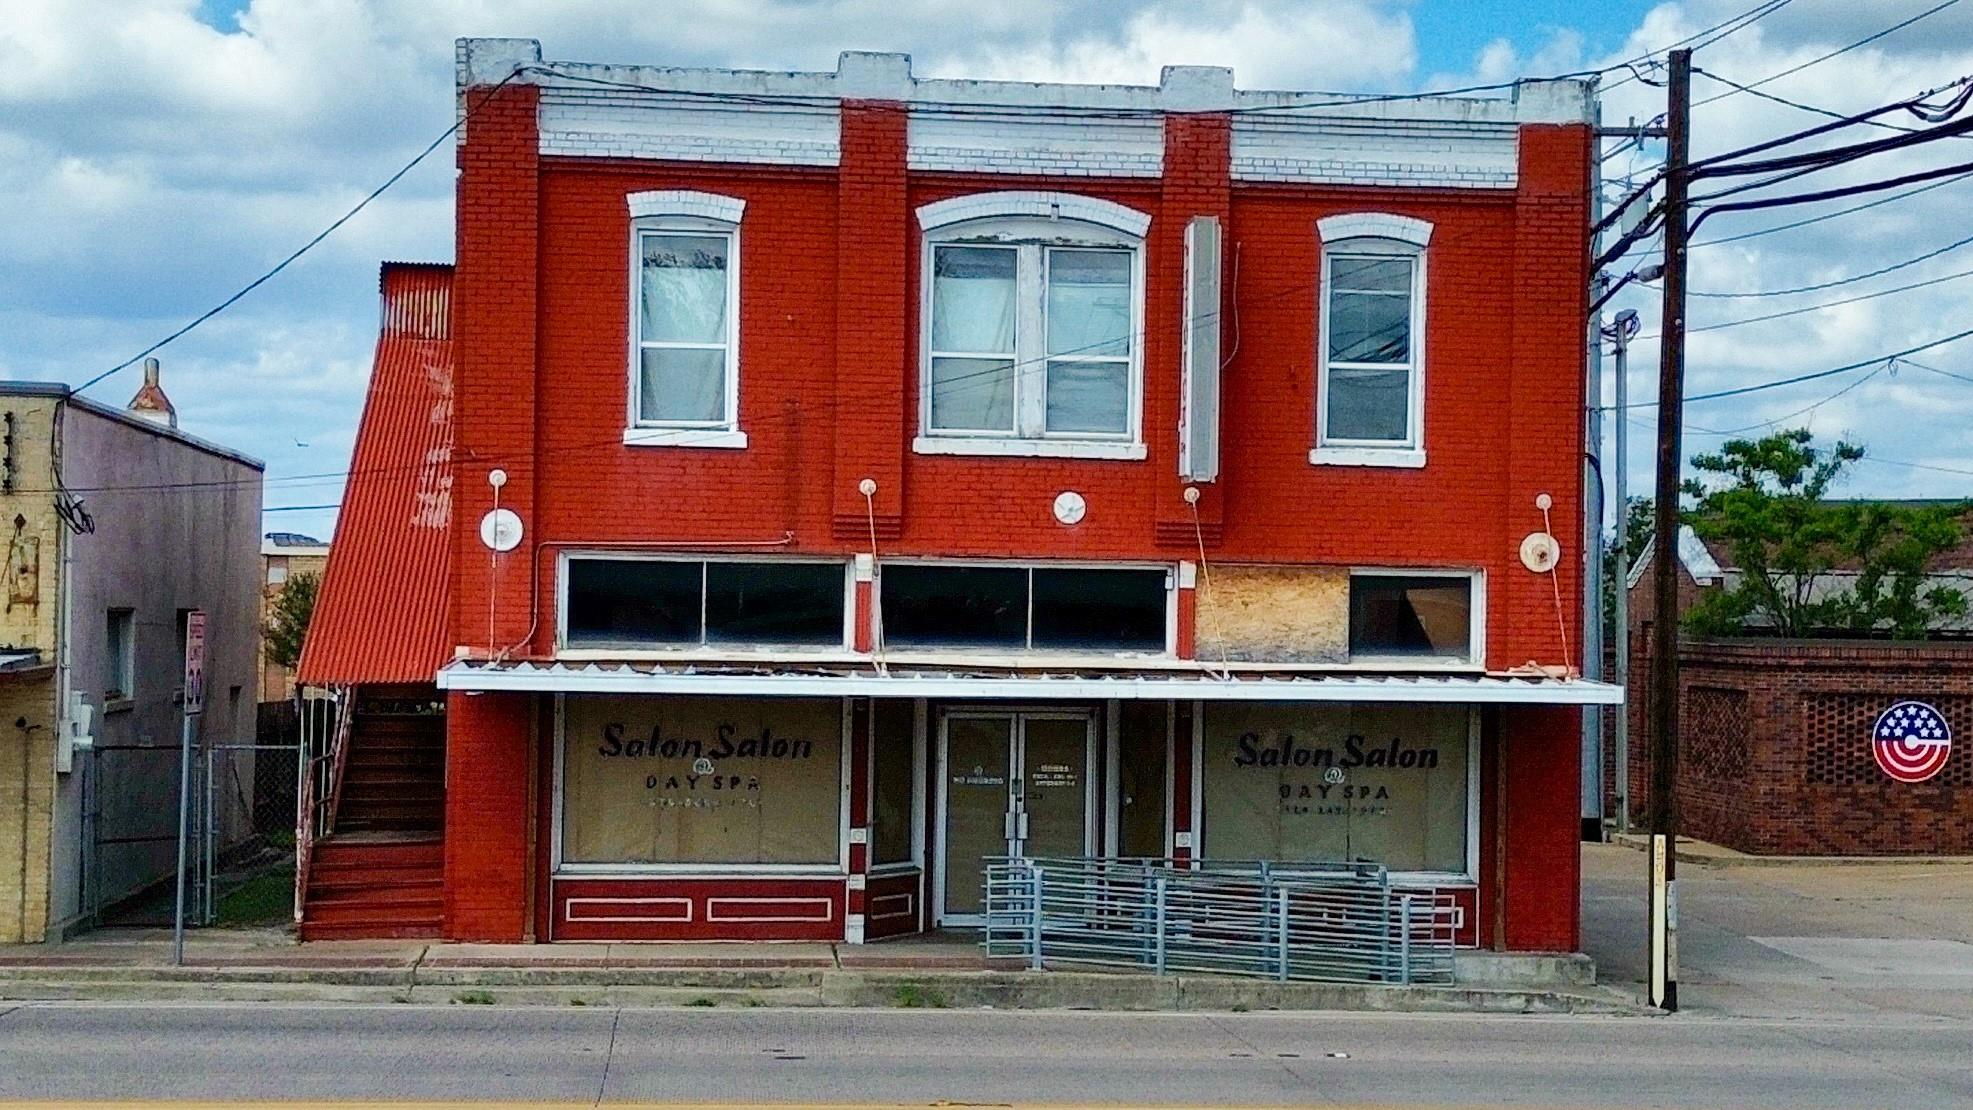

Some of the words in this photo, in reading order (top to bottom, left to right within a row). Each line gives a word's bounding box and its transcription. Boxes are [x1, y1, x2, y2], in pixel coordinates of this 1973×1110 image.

[599, 722, 701, 758] Salon
[708, 724, 813, 759] Salon
[1234, 731, 1334, 768] Salon
[1339, 734, 1438, 769] Salon
[646, 774, 700, 790] DAY
[712, 775, 760, 791] SPA
[1279, 784, 1332, 799] DAY
[1343, 785, 1389, 800] SPA
